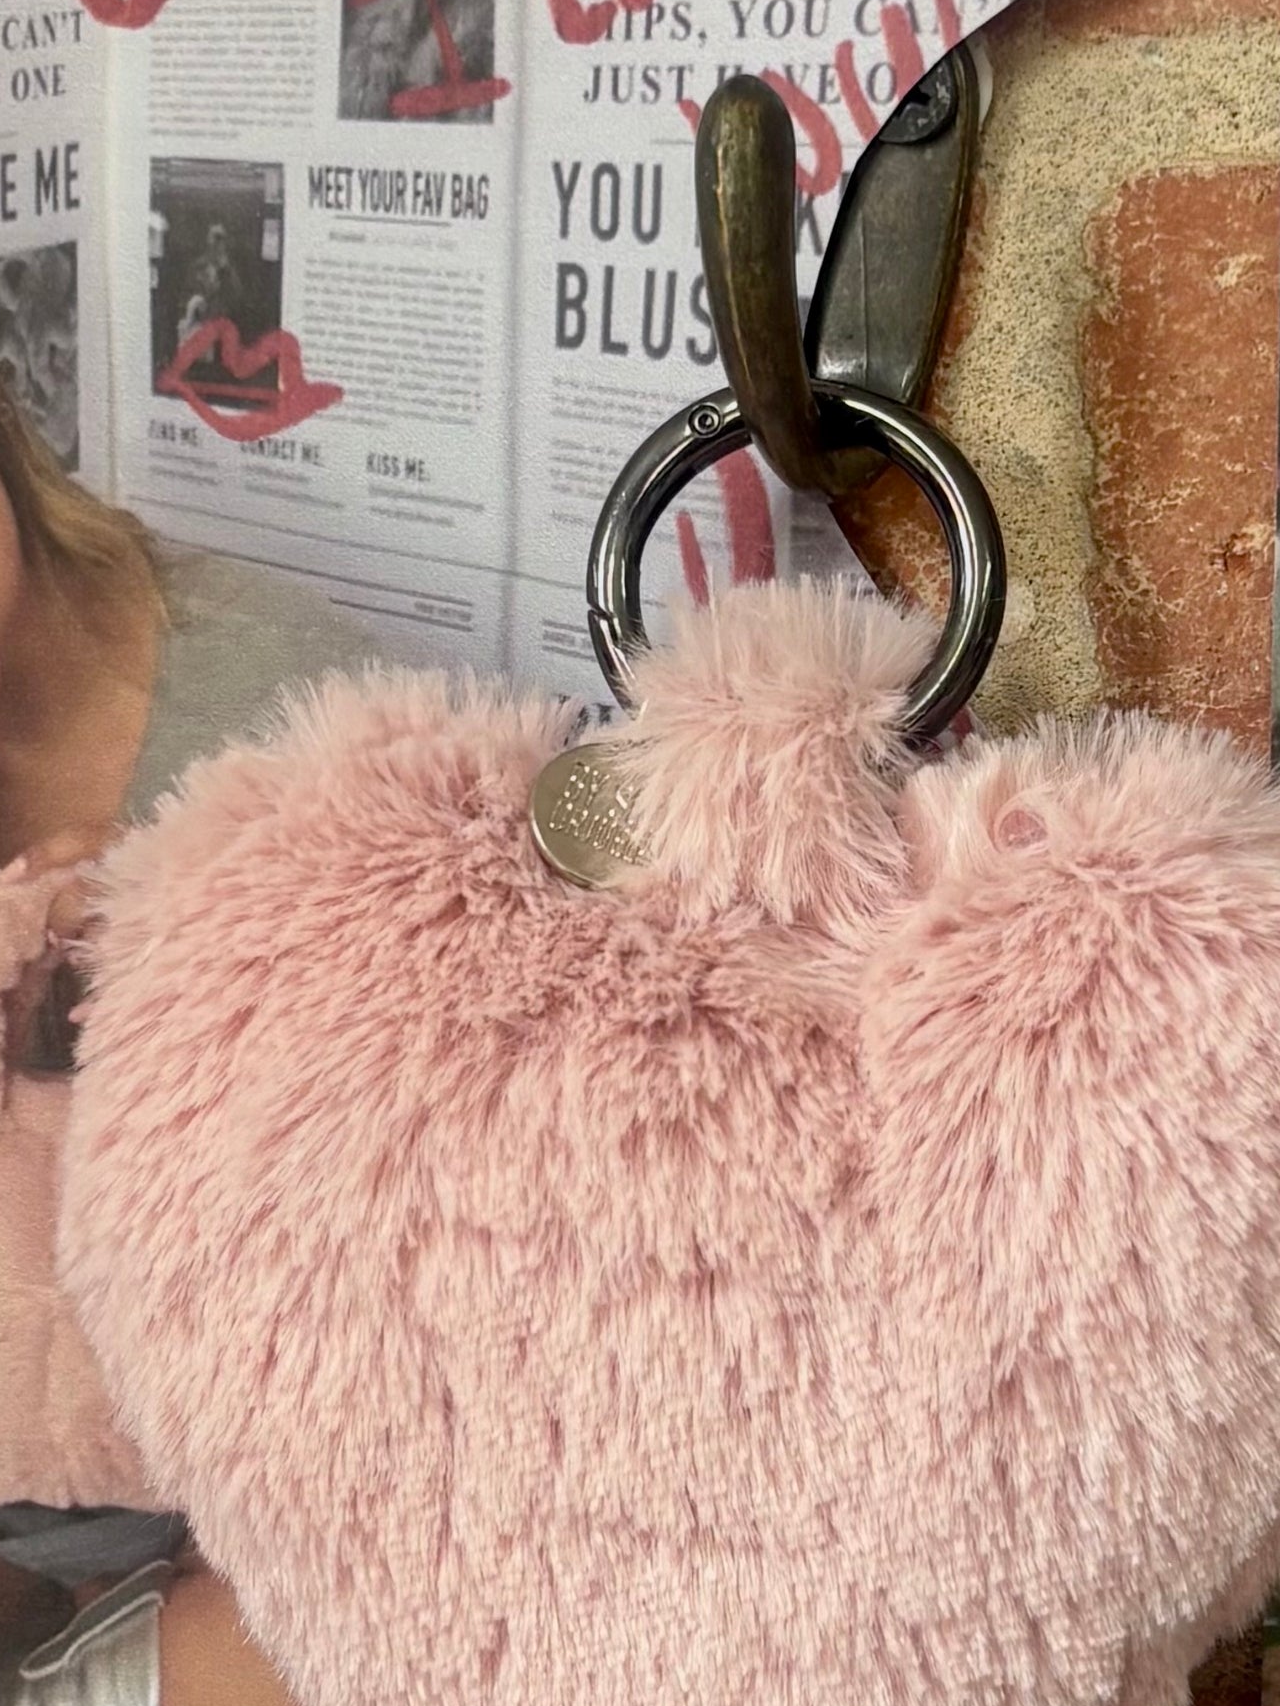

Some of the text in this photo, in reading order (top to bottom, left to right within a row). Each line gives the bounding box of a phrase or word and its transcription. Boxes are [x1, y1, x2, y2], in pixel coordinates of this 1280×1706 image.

[1, 8, 86, 51] CAN'T
[11, 64, 67, 103] ONE
[582, 63, 695, 106] JUST
[34, 141, 81, 217] ME
[308, 165, 490, 220] MEET YOUR FAV BAG
[551, 160, 664, 246] YOU
[365, 452, 402, 479] KISS
